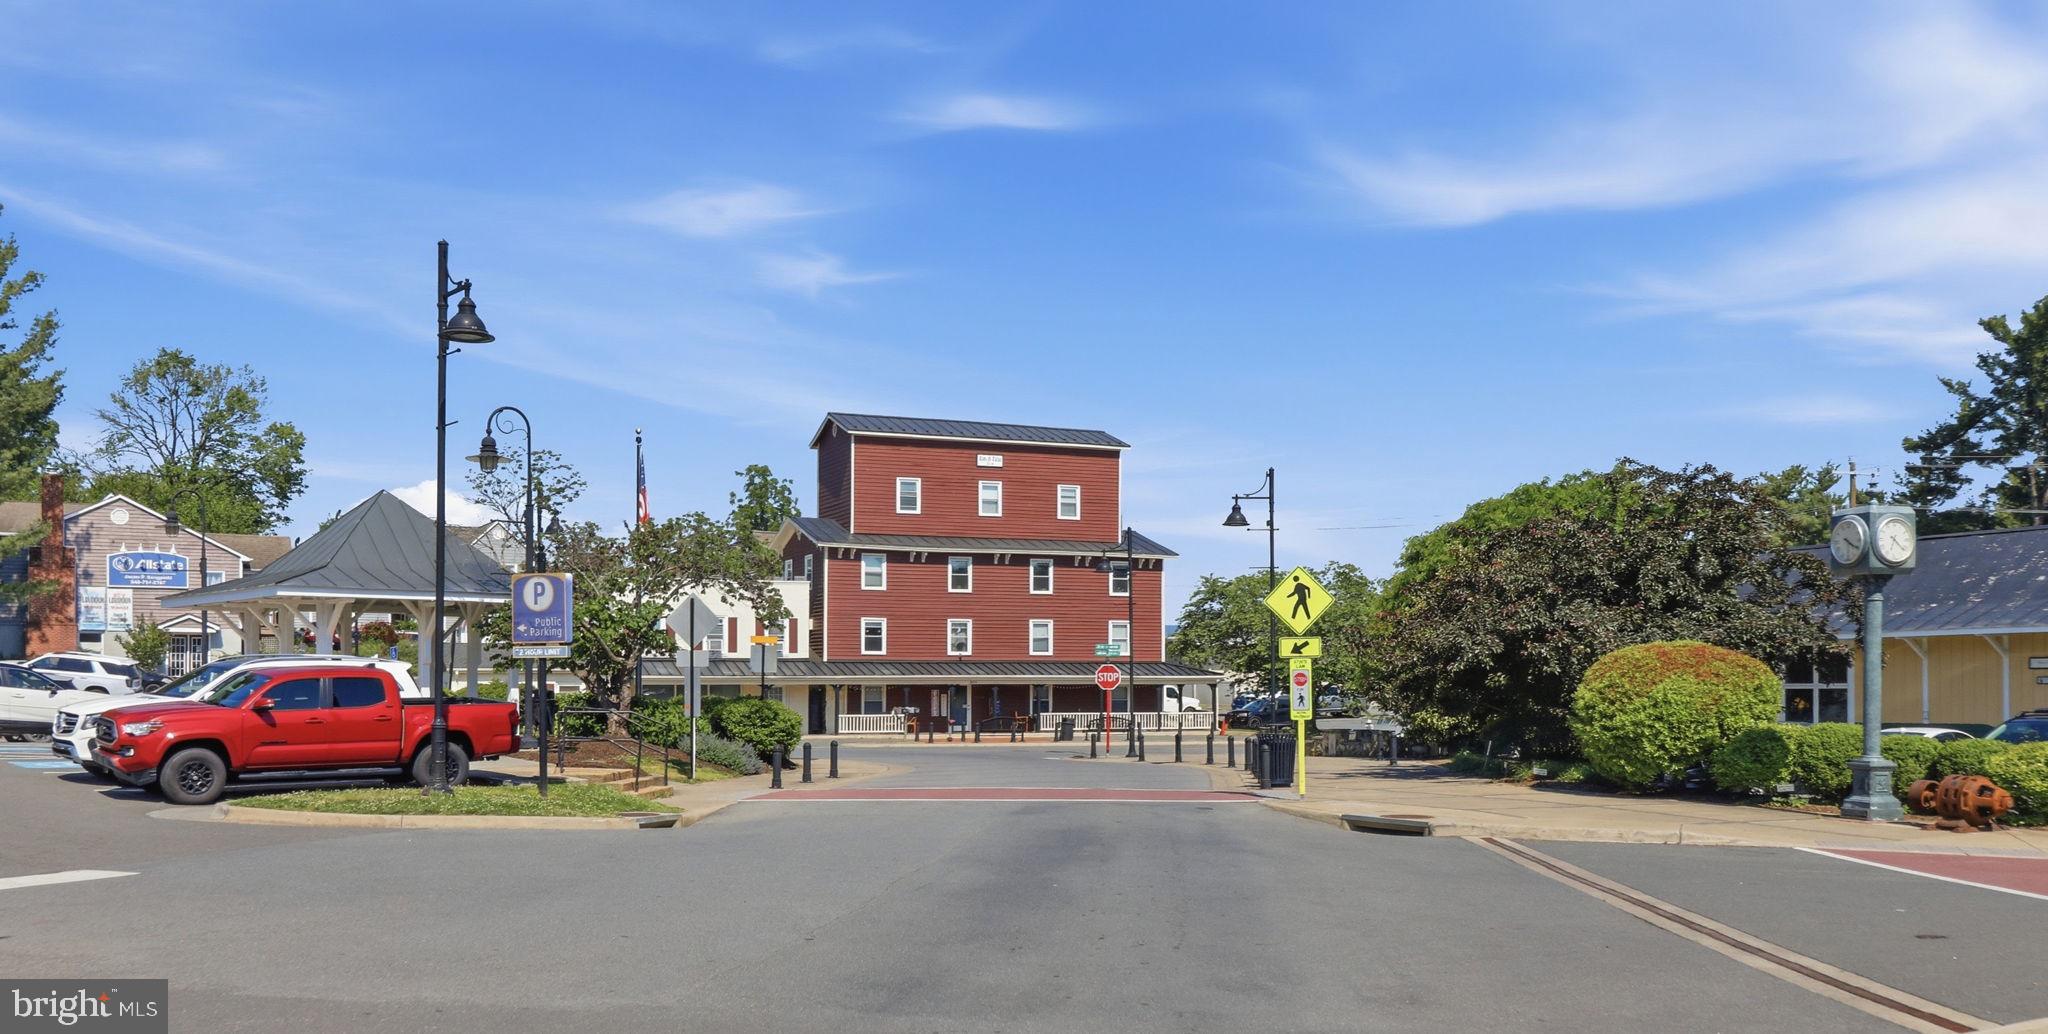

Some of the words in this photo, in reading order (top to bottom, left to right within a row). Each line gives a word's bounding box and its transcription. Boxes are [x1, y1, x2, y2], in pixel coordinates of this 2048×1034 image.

[135, 559, 184, 570] Allstate
[533, 581, 546, 605] P
[535, 617, 562, 626] Public
[530, 627, 562, 637] Parking
[1098, 672, 1119, 682] STOP
